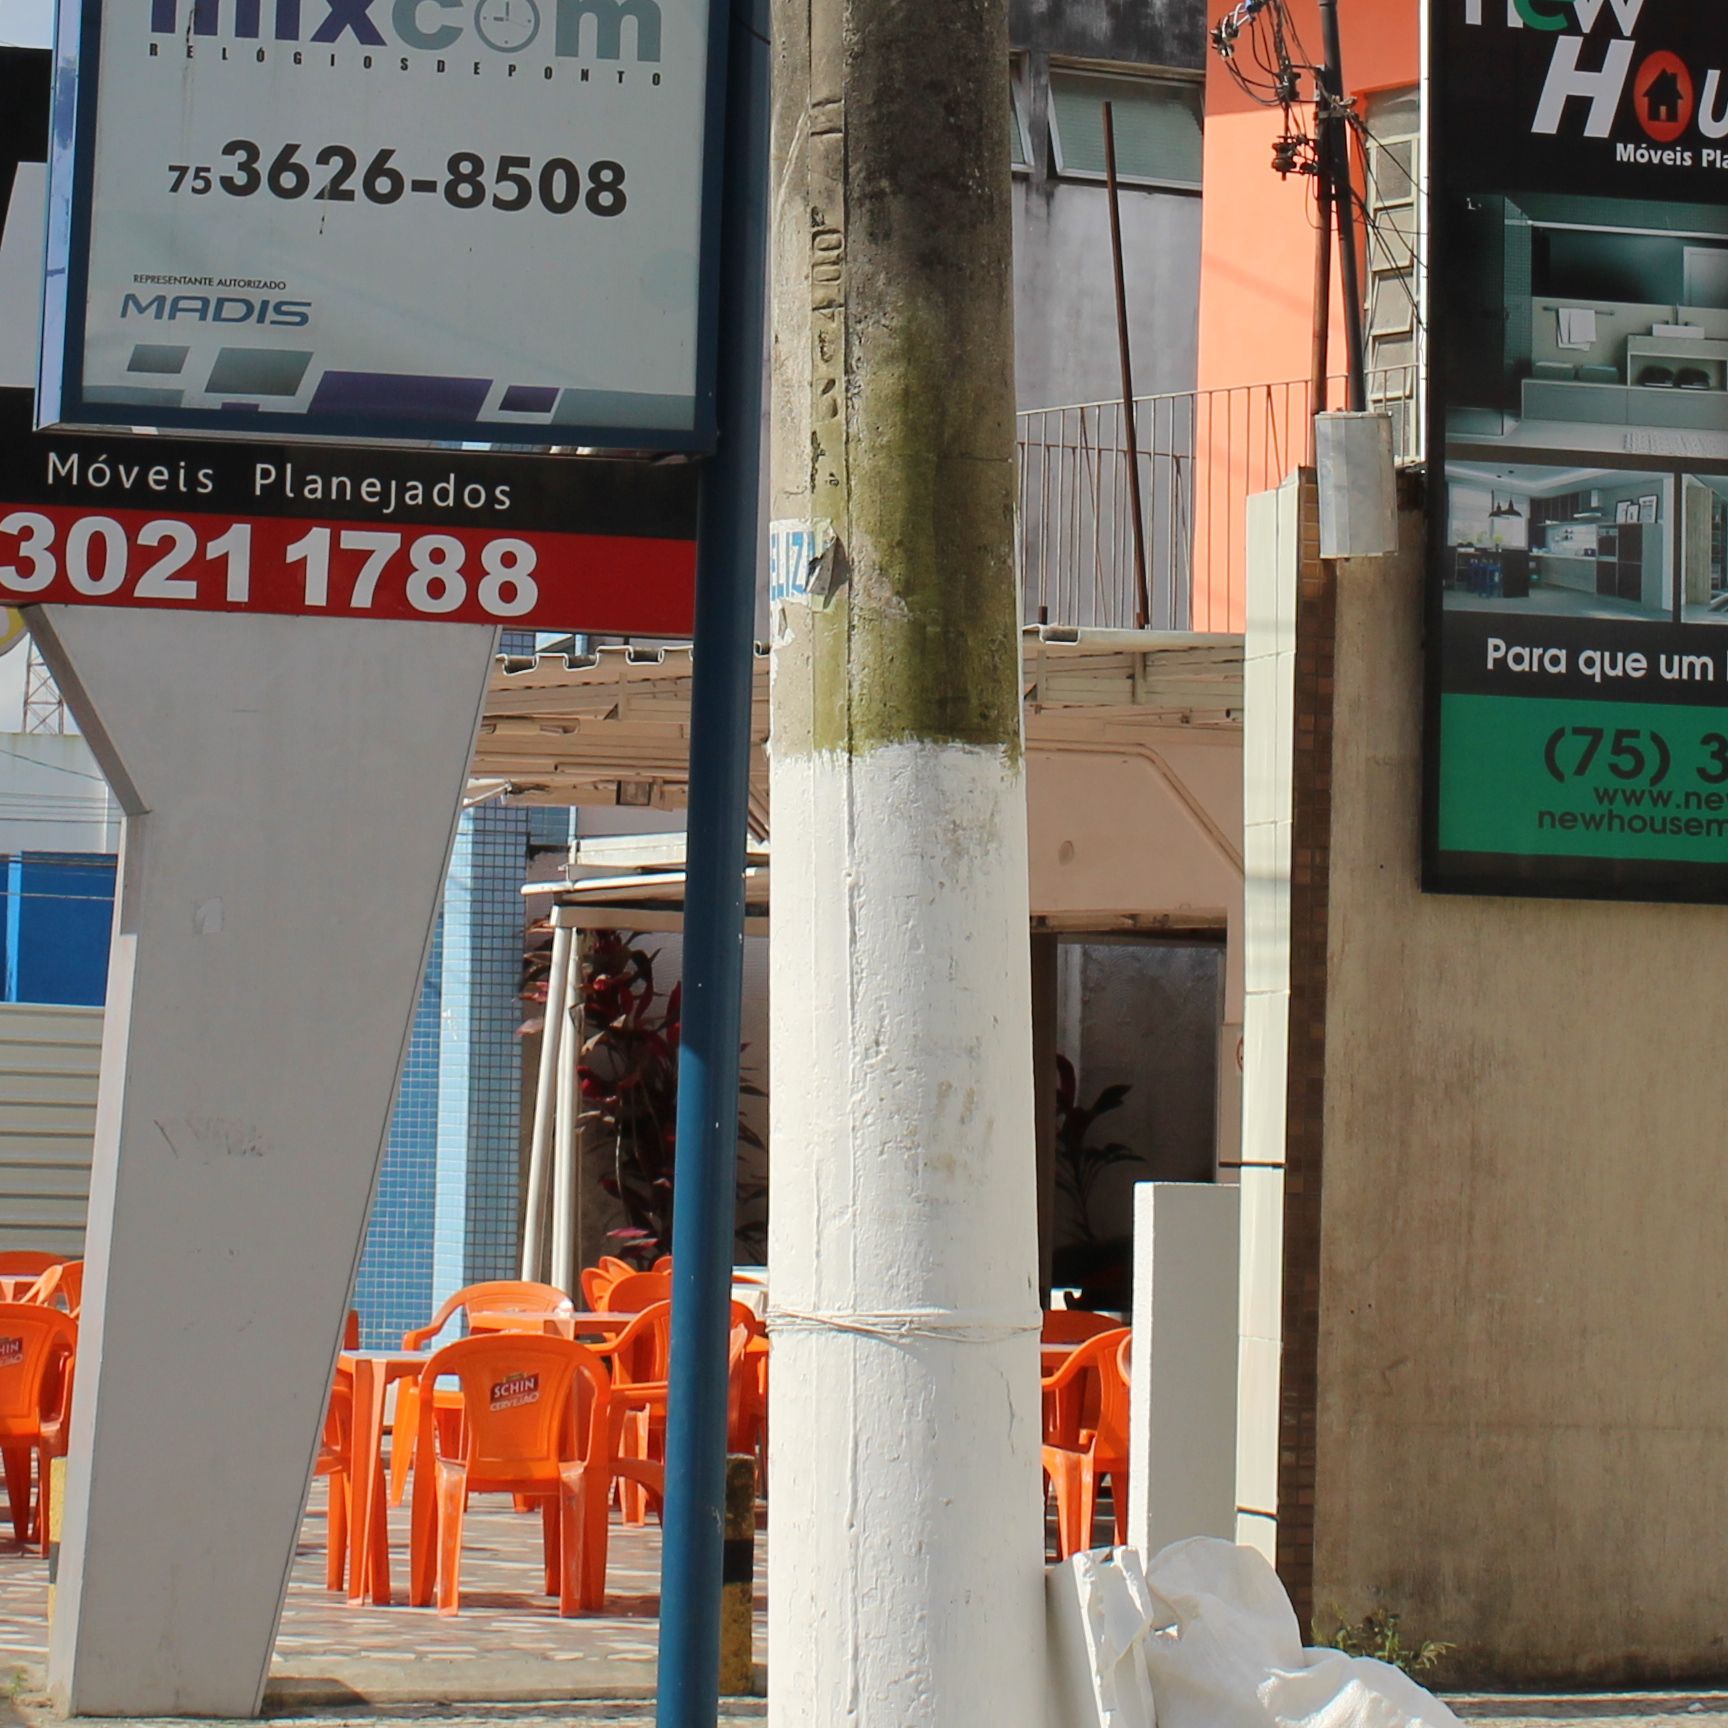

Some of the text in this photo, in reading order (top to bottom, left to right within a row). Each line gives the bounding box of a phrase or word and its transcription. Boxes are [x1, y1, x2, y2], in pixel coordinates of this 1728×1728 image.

[1615, 142, 1693, 167] Móveis
[167, 138, 629, 218] 75 3626-8508
[132, 274, 288, 291] REPRESENTANTE AUTORIZADO
[120, 293, 313, 327] MADIS
[46, 451, 513, 514] Móveis Planejados
[284, 526, 540, 617] 1788
[1486, 637, 1567, 673] Para
[1578, 649, 1648, 683] que
[1659, 653, 1714, 681] um
[1544, 726, 1671, 787] (75)
[493, 1377, 535, 1399] SCHIN
